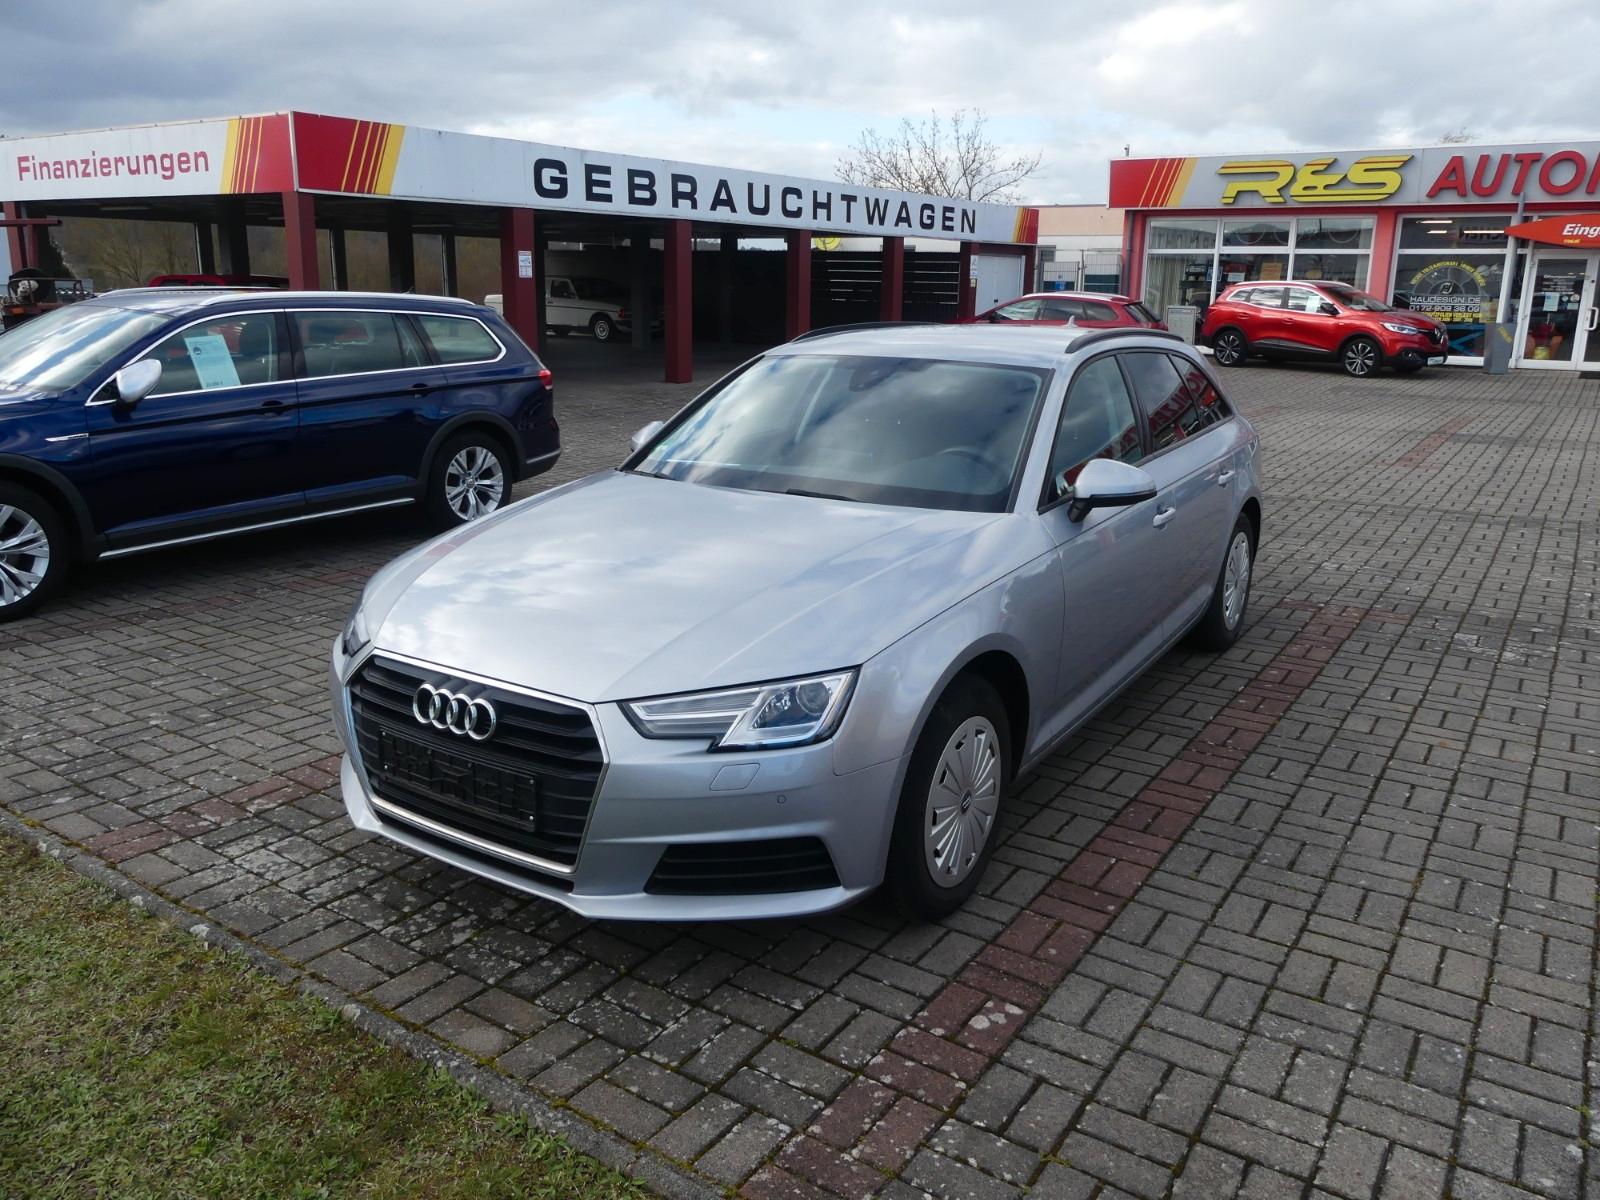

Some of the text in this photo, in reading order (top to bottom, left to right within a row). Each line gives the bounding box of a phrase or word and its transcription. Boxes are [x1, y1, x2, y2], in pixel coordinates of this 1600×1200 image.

[17, 150, 209, 182] Finanzierungen
[1216, 154, 1414, 204] R&S
[533, 158, 977, 234] GEBRAUCHTWAGEN
[1562, 223, 1600, 238] Eing
